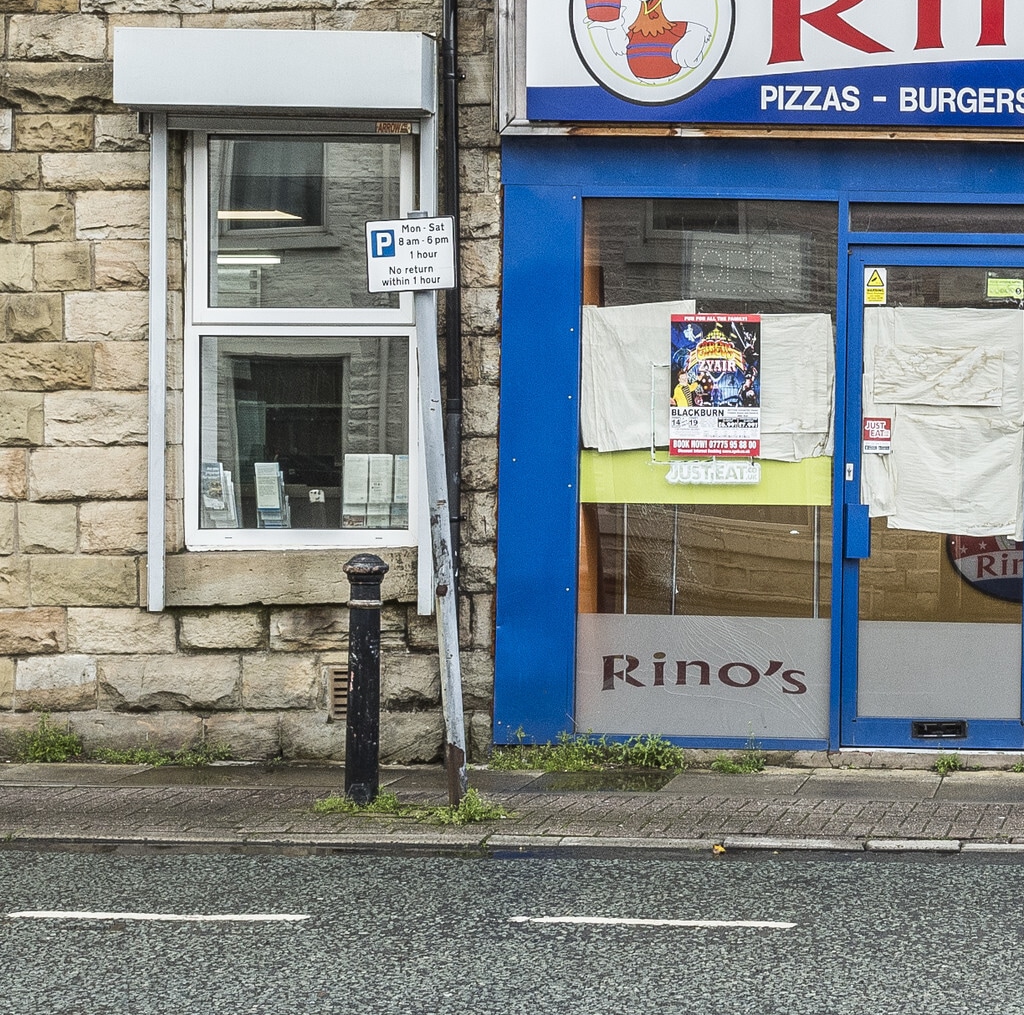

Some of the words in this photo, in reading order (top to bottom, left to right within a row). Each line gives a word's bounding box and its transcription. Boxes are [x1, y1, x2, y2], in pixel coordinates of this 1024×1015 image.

[760, 85, 860, 112] PIZZAS
[402, 224, 421, 233] Mon
[429, 223, 445, 231] Sat
[376, 232, 392, 256] P
[399, 237, 404, 245] 8
[427, 236, 432, 244] 6
[435, 237, 449, 245] pm
[389, 266, 401, 274] No
[405, 265, 433, 274] return
[382, 277, 410, 286] within
[420, 276, 440, 284] hour
[699, 360, 736, 371] ZYAIR
[673, 440, 690, 448] BOOK
[601, 651, 807, 694] Rino's
